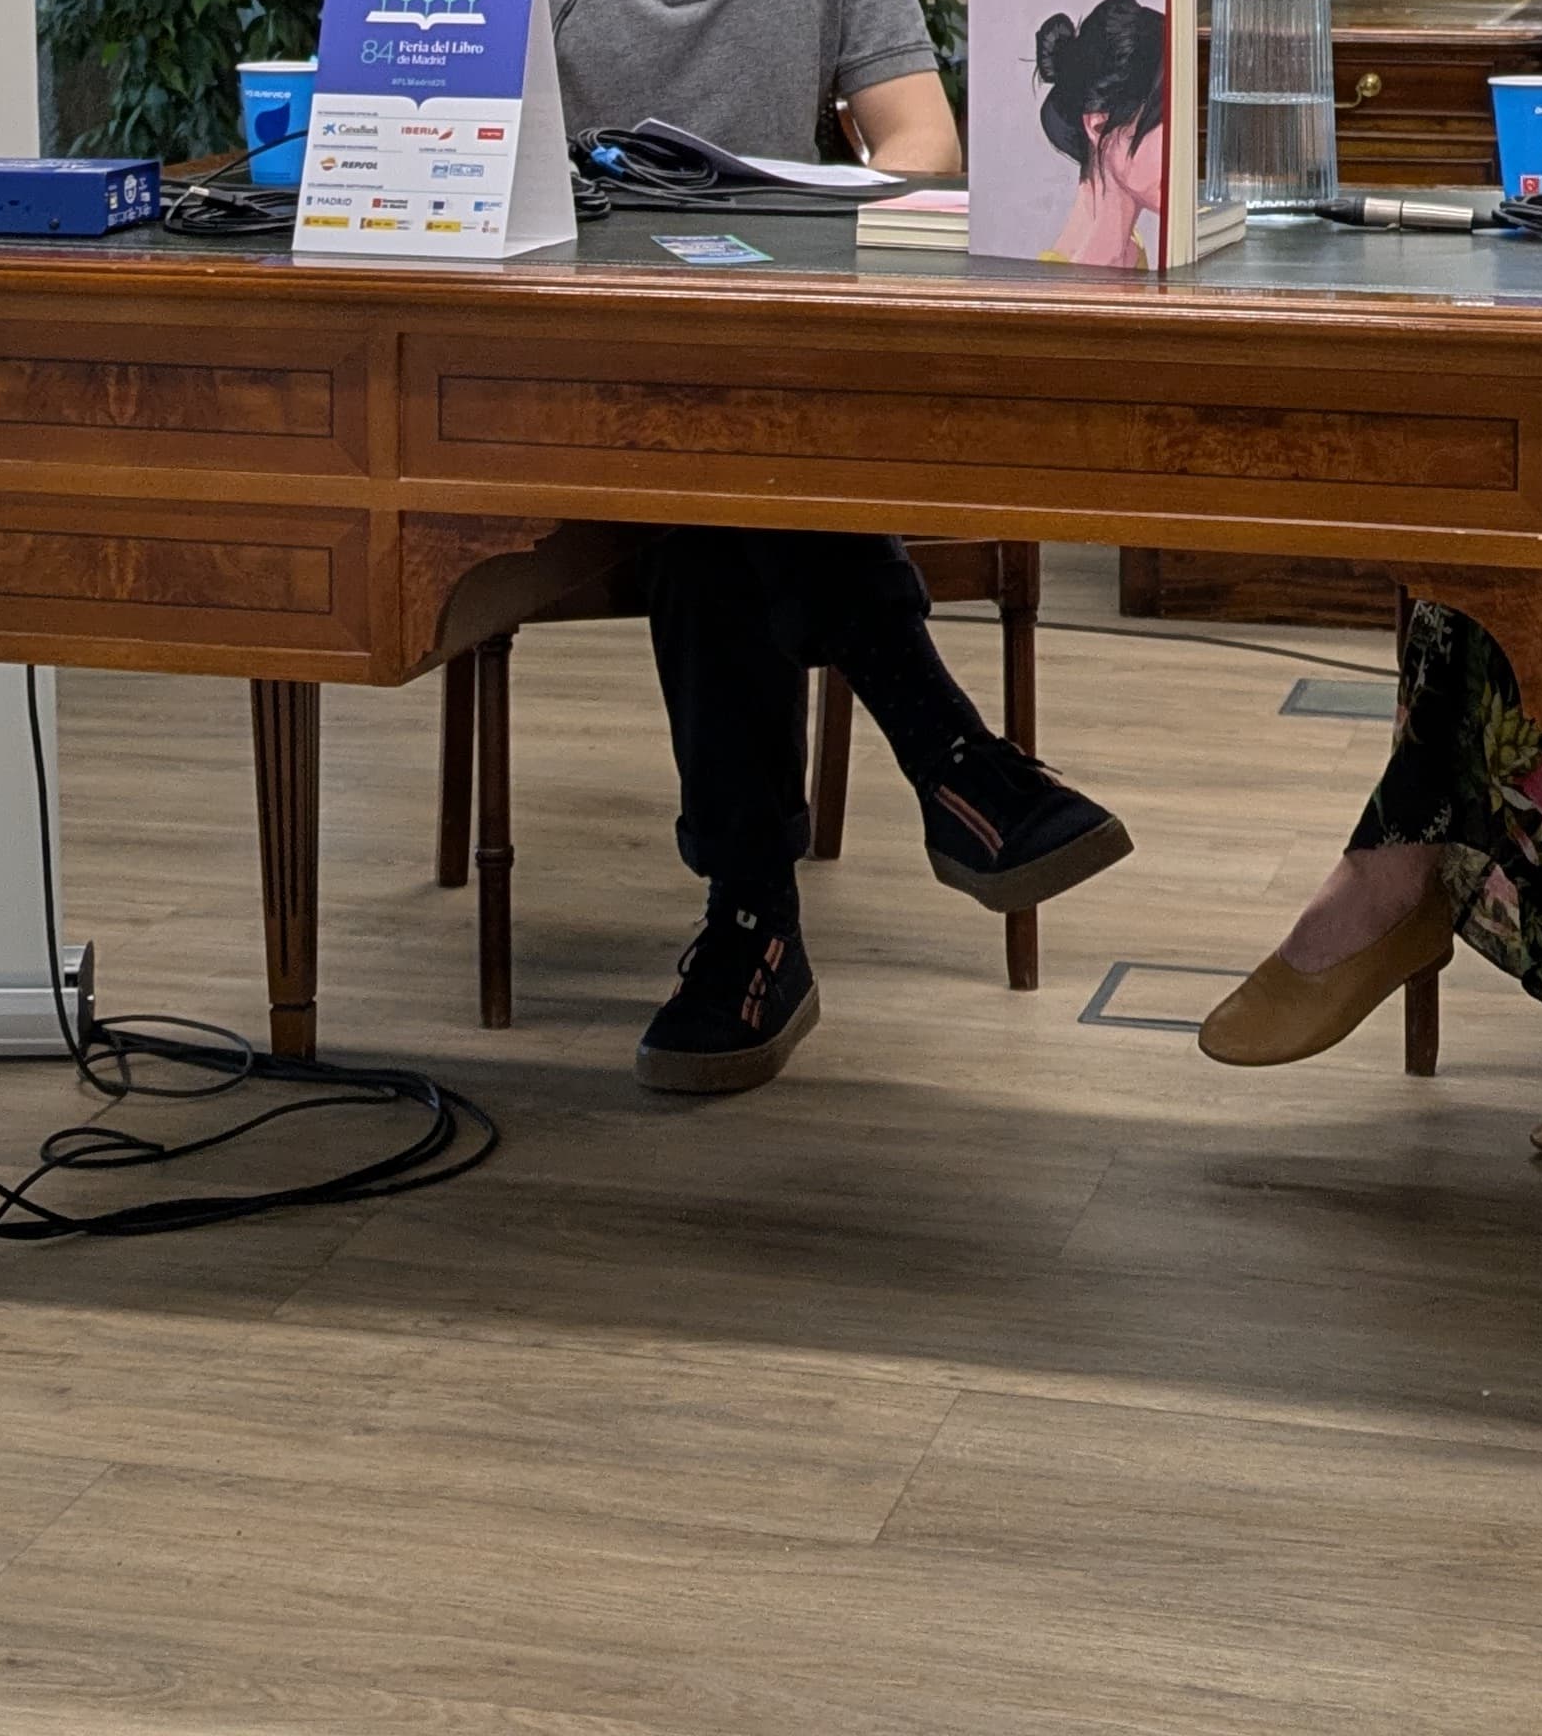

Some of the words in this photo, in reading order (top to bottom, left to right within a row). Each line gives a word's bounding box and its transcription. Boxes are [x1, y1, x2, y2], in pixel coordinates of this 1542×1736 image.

[361, 40, 394, 64] 84
[399, 40, 429, 53] Feria
[431, 40, 449, 53] del
[451, 41, 484, 54] Libro
[396, 55, 410, 64] de
[412, 54, 446, 65] Madrid
[401, 127, 439, 136] IBERIA
[341, 160, 378, 170] REPSOL
